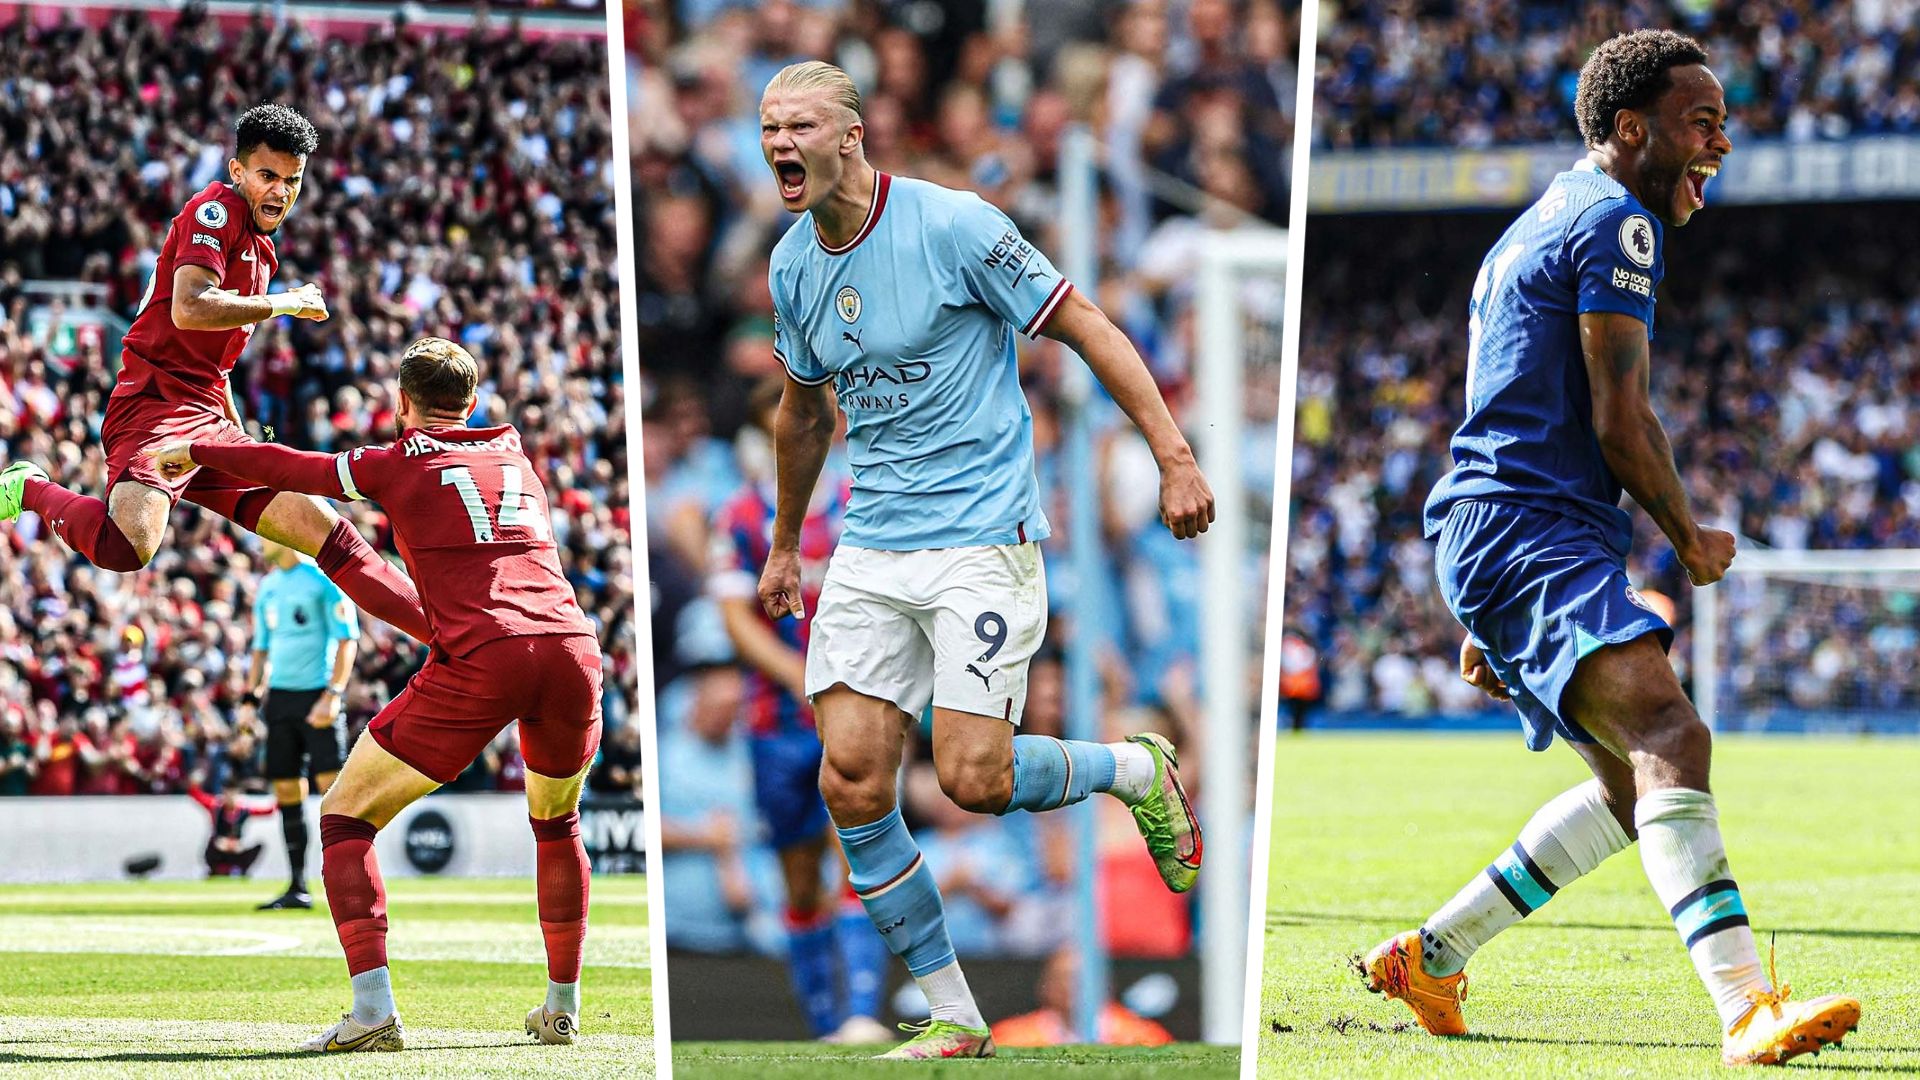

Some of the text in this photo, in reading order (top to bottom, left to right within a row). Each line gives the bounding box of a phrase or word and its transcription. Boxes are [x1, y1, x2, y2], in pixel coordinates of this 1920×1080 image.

[983, 229, 1018, 270] NEXE
[1002, 241, 1032, 272] TIRE
[1613, 267, 1630, 281] No
[847, 393, 910, 409] RWAYS
[404, 432, 523, 457] HENDERSO
[441, 465, 550, 544] 14
[974, 611, 1008, 663] 9
